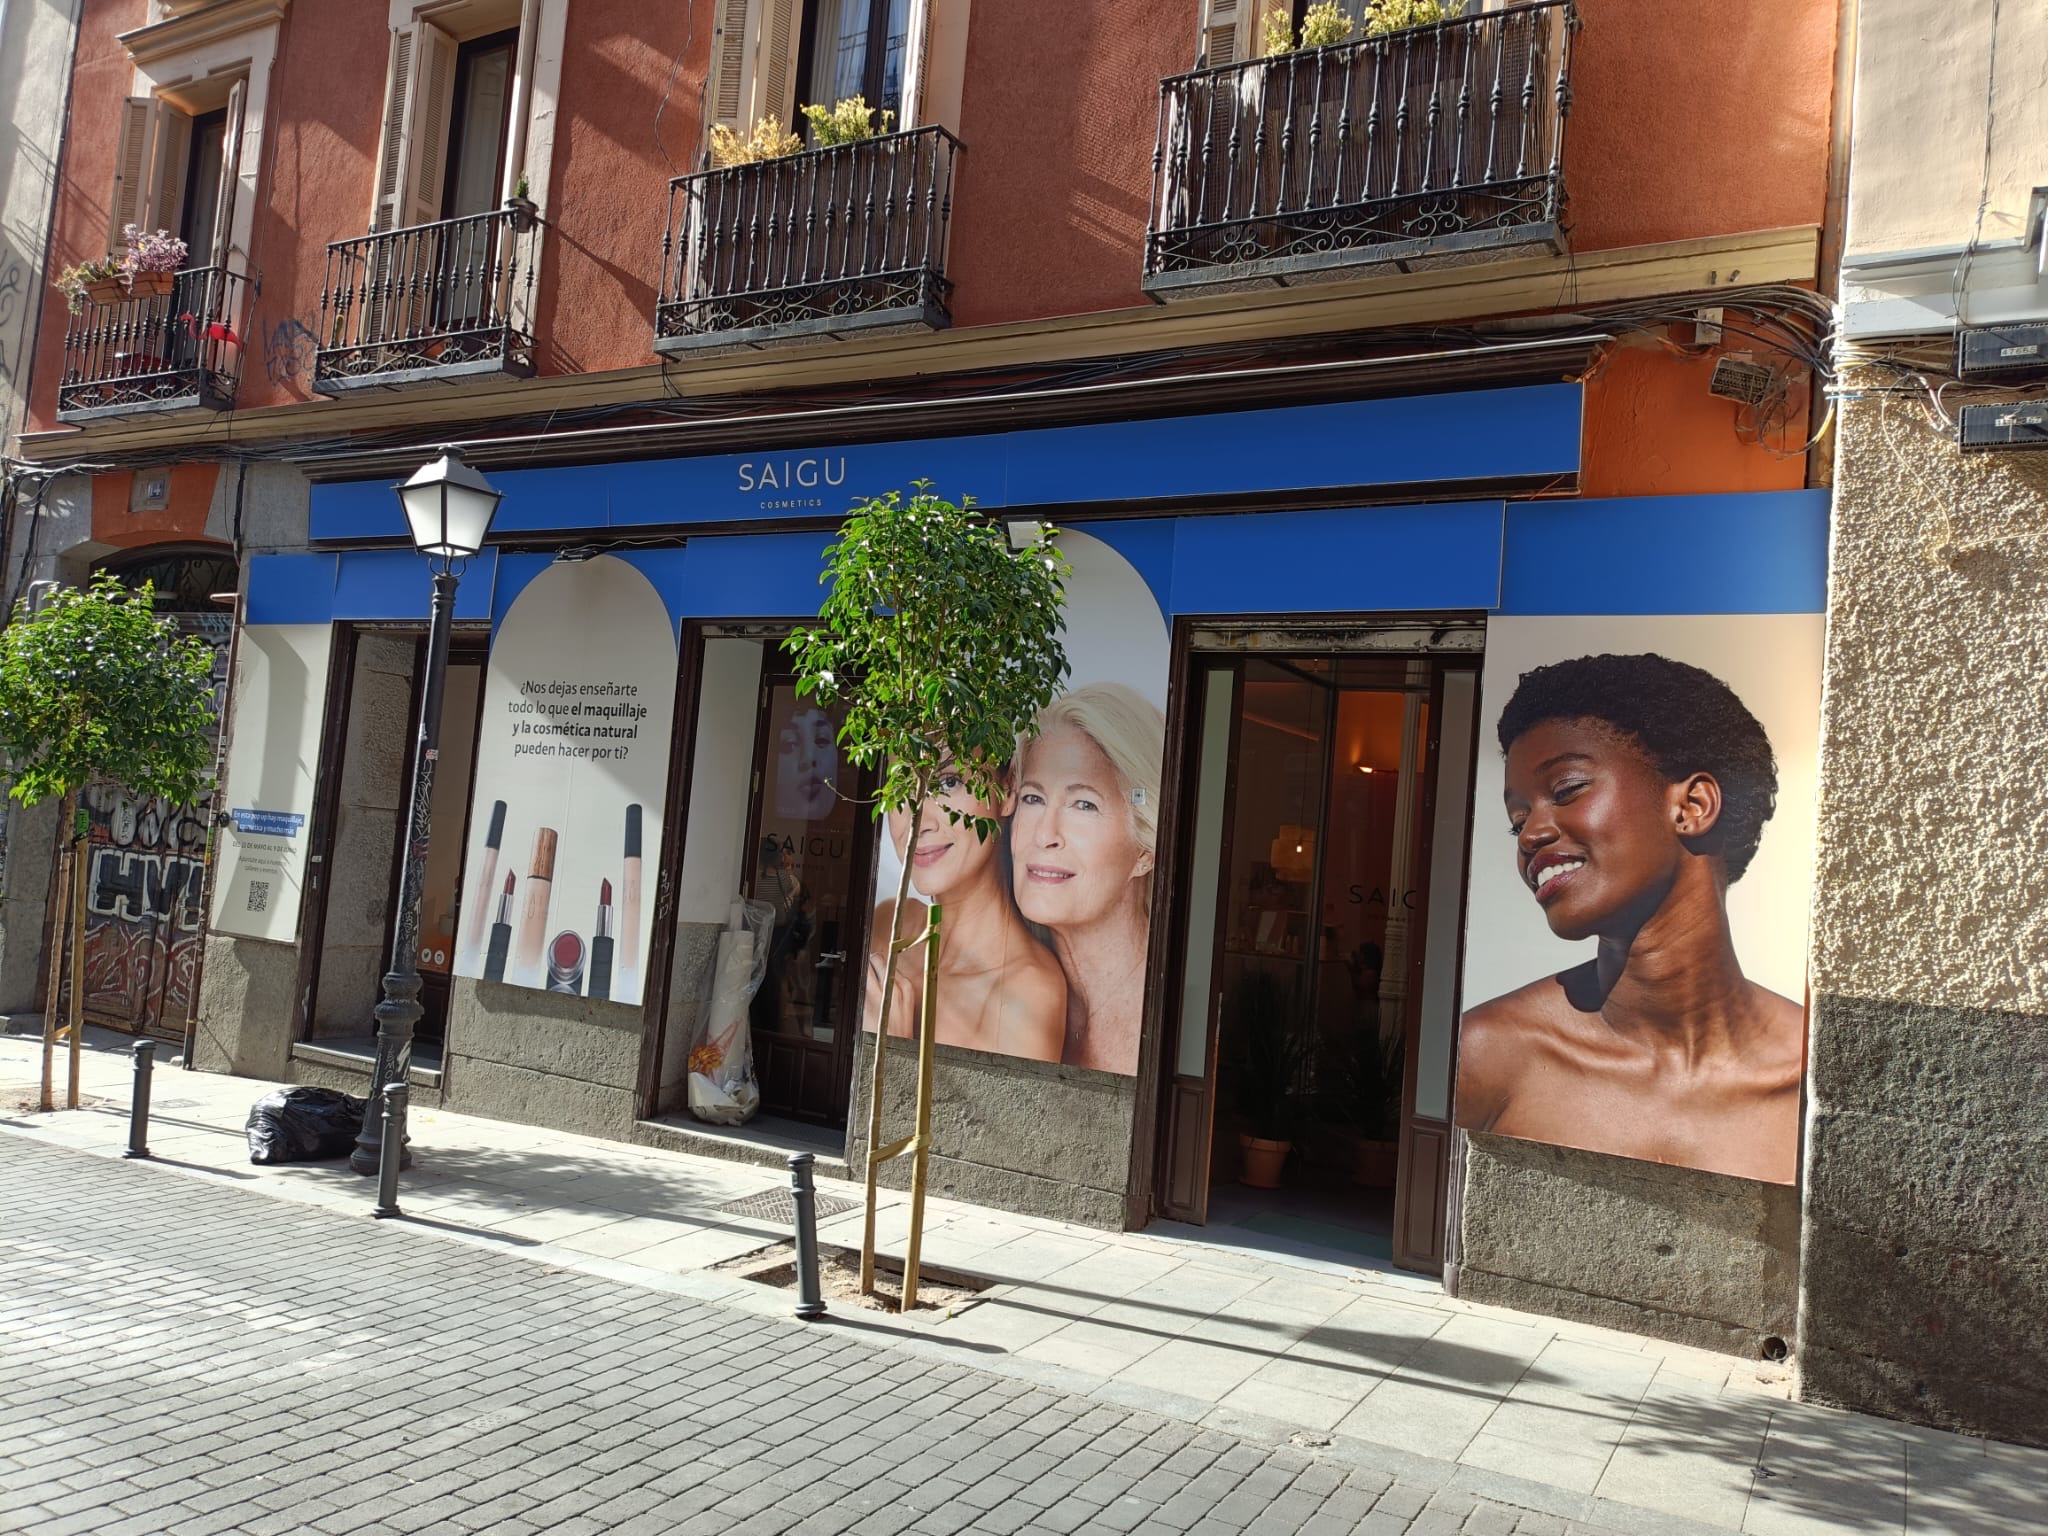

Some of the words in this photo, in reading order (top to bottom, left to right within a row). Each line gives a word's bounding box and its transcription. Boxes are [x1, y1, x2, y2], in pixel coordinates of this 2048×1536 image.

[738, 457, 846, 491] SAIGU
[760, 499, 822, 509] COSMETICS
[520, 680, 546, 696] ¿Nos
[548, 680, 577, 698] dejas
[580, 681, 638, 696] enseñarte
[508, 700, 533, 713] todo
[536, 700, 546, 714] lo
[548, 704, 569, 718] que
[571, 702, 582, 715] el
[584, 703, 647, 721] maquillaje
[512, 723, 520, 736] y
[521, 720, 531, 734] la
[533, 721, 591, 737] cosmética
[593, 724, 638, 739] natural
[514, 741, 556, 757] pueden
[558, 742, 590, 758] hacer
[592, 747, 612, 762] por
[614, 745, 629, 759] ti?
[765, 833, 844, 858] SAIGU
